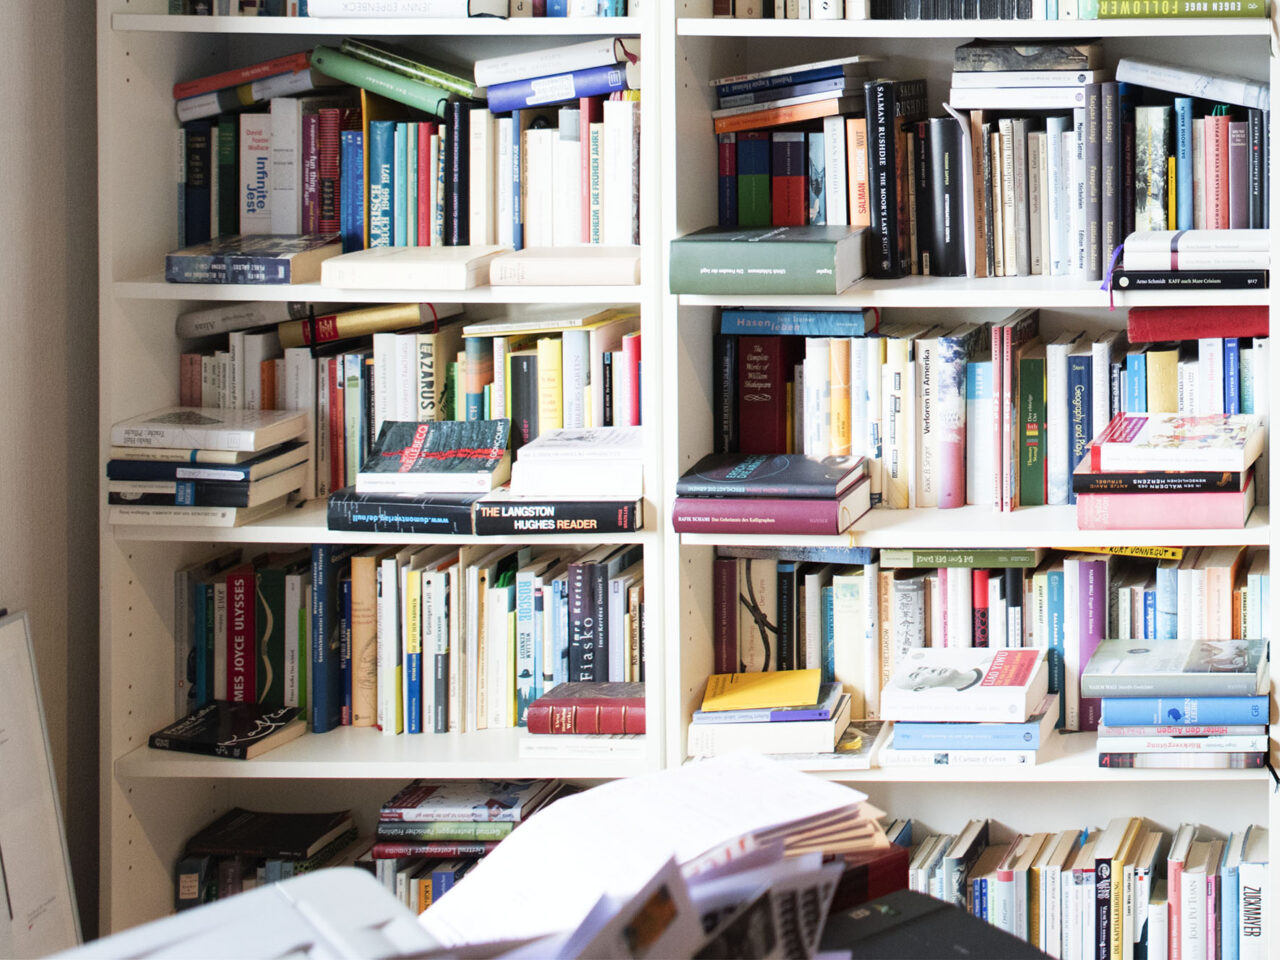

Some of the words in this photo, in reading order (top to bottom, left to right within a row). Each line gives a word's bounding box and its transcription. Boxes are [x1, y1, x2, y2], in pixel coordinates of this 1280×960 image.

[342, 2, 398, 13] ERPENBECK
[400, 2, 432, 13] JENNY
[1100, 0, 1178, 15] FOLLOWER
[1185, 2, 1208, 12] RUGE
[1212, 2, 1241, 12] EUGEN
[877, 86, 886, 123] SALMAN
[590, 131, 599, 156] JAHRE
[855, 130, 865, 146] WUT
[878, 126, 887, 165] RUSHDIE
[355, 148, 364, 174] Stiller
[255, 157, 269, 209] Infinite
[381, 164, 390, 184] 1971
[590, 158, 600, 191] FRÜHEN
[879, 172, 887, 185] THE
[246, 184, 256, 214] Jest
[355, 179, 364, 206] Frisch
[380, 188, 390, 210] 1966
[591, 192, 600, 205] DIE
[857, 183, 867, 214] SALMAN
[880, 187, 888, 212] MOOR'S
[355, 207, 364, 224] Max
[370, 184, 381, 235] FRISCH
[881, 237, 889, 255] SIGH
[736, 318, 771, 328] Hasen
[771, 322, 799, 332] leben
[753, 345, 763, 353] The
[419, 343, 435, 417] LAZARUS
[922, 349, 930, 389] Amerika
[922, 390, 930, 398] in
[1075, 384, 1085, 423] Geography
[922, 401, 930, 435] Verloren
[1075, 424, 1085, 438] and
[1074, 440, 1084, 456] Plays
[481, 506, 500, 516] THE
[502, 506, 554, 517] LANGSTON
[514, 518, 555, 529] HUGHES
[557, 518, 597, 529] READER
[1108, 546, 1129, 554] KURT
[1132, 548, 1170, 558] VONNEGUT
[233, 577, 245, 630] ULYSSES
[519, 581, 532, 621] ROSCOE
[572, 568, 581, 618] Kertész
[573, 619, 581, 647] Imre
[233, 632, 245, 672] JOYCE
[580, 616, 594, 681] Fiasko
[991, 651, 1008, 671] YIWU
[1242, 886, 1262, 938] ZUCKMAYER
